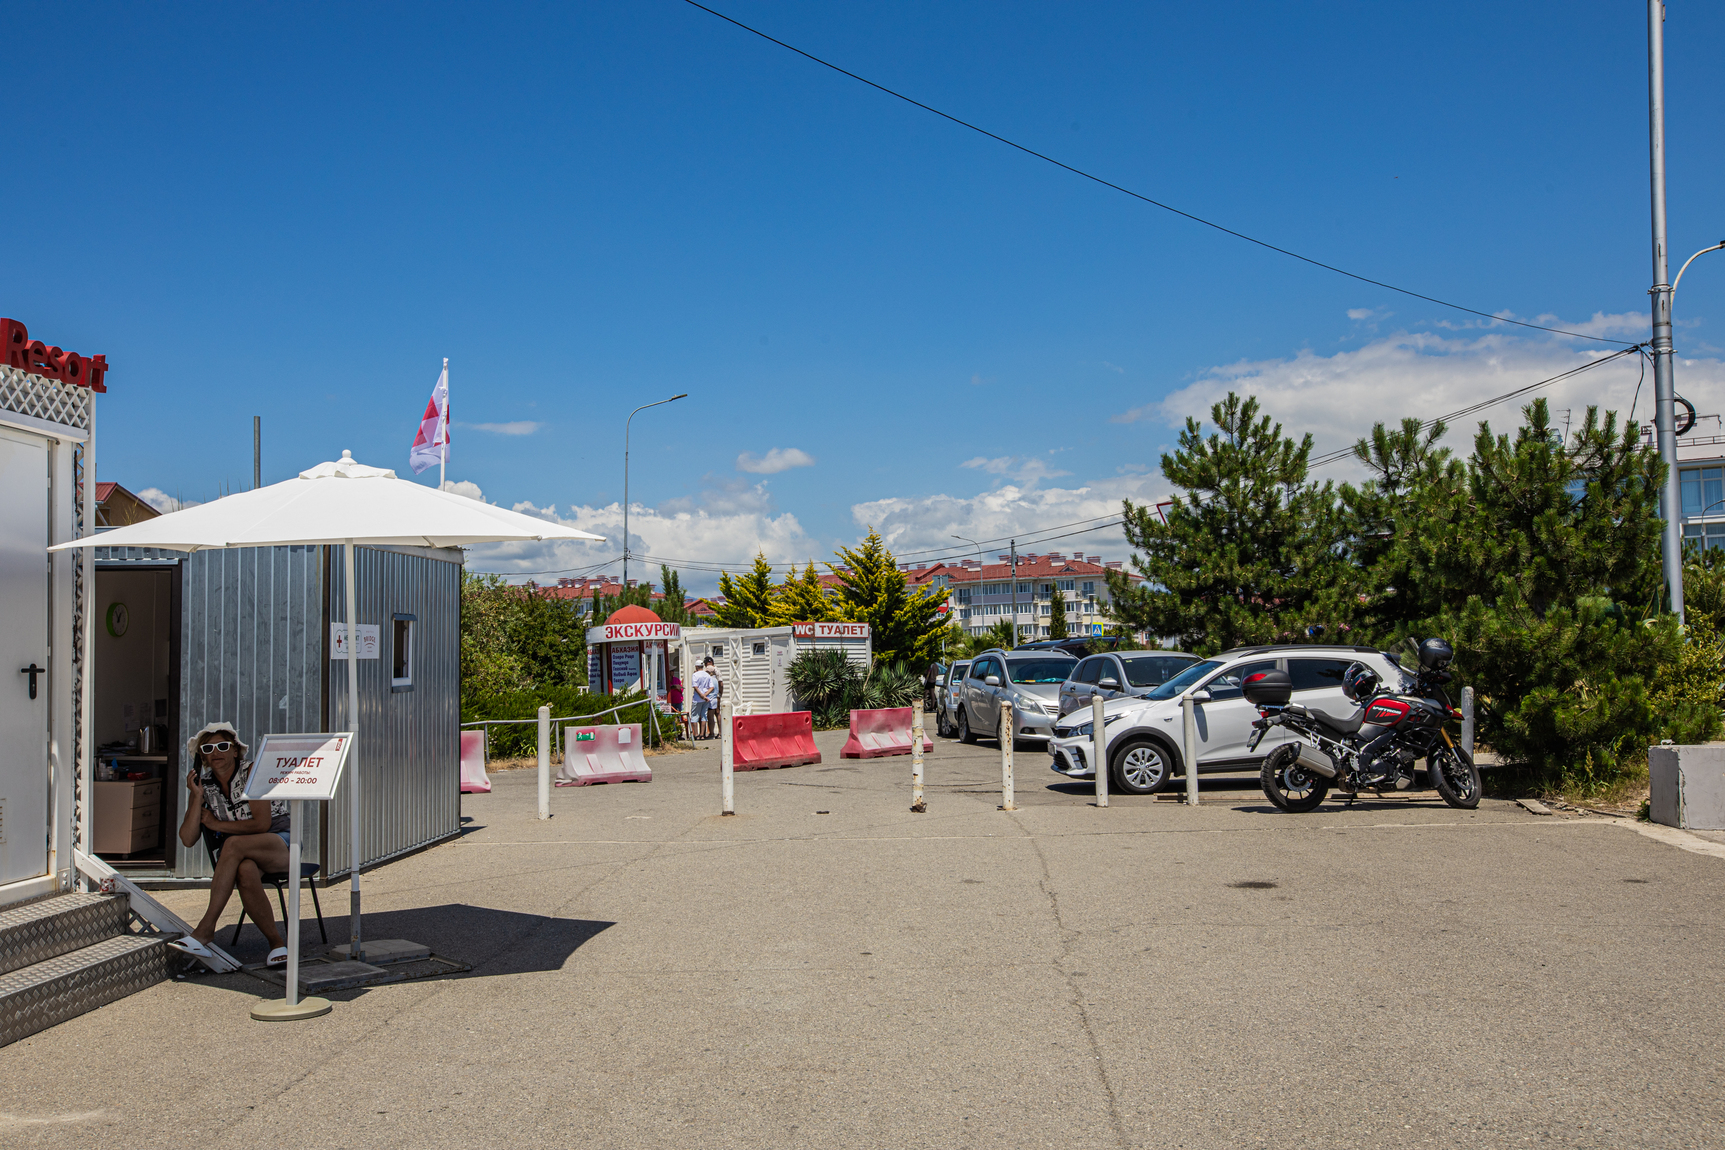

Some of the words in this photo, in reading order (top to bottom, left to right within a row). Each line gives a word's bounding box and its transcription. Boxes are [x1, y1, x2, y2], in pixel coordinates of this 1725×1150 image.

[0, 317, 109, 393] Resort
[794, 624, 814, 634] WC
[819, 625, 865, 635] ТУАЛЕТ
[276, 757, 324, 768] ТУАЛЕТ
